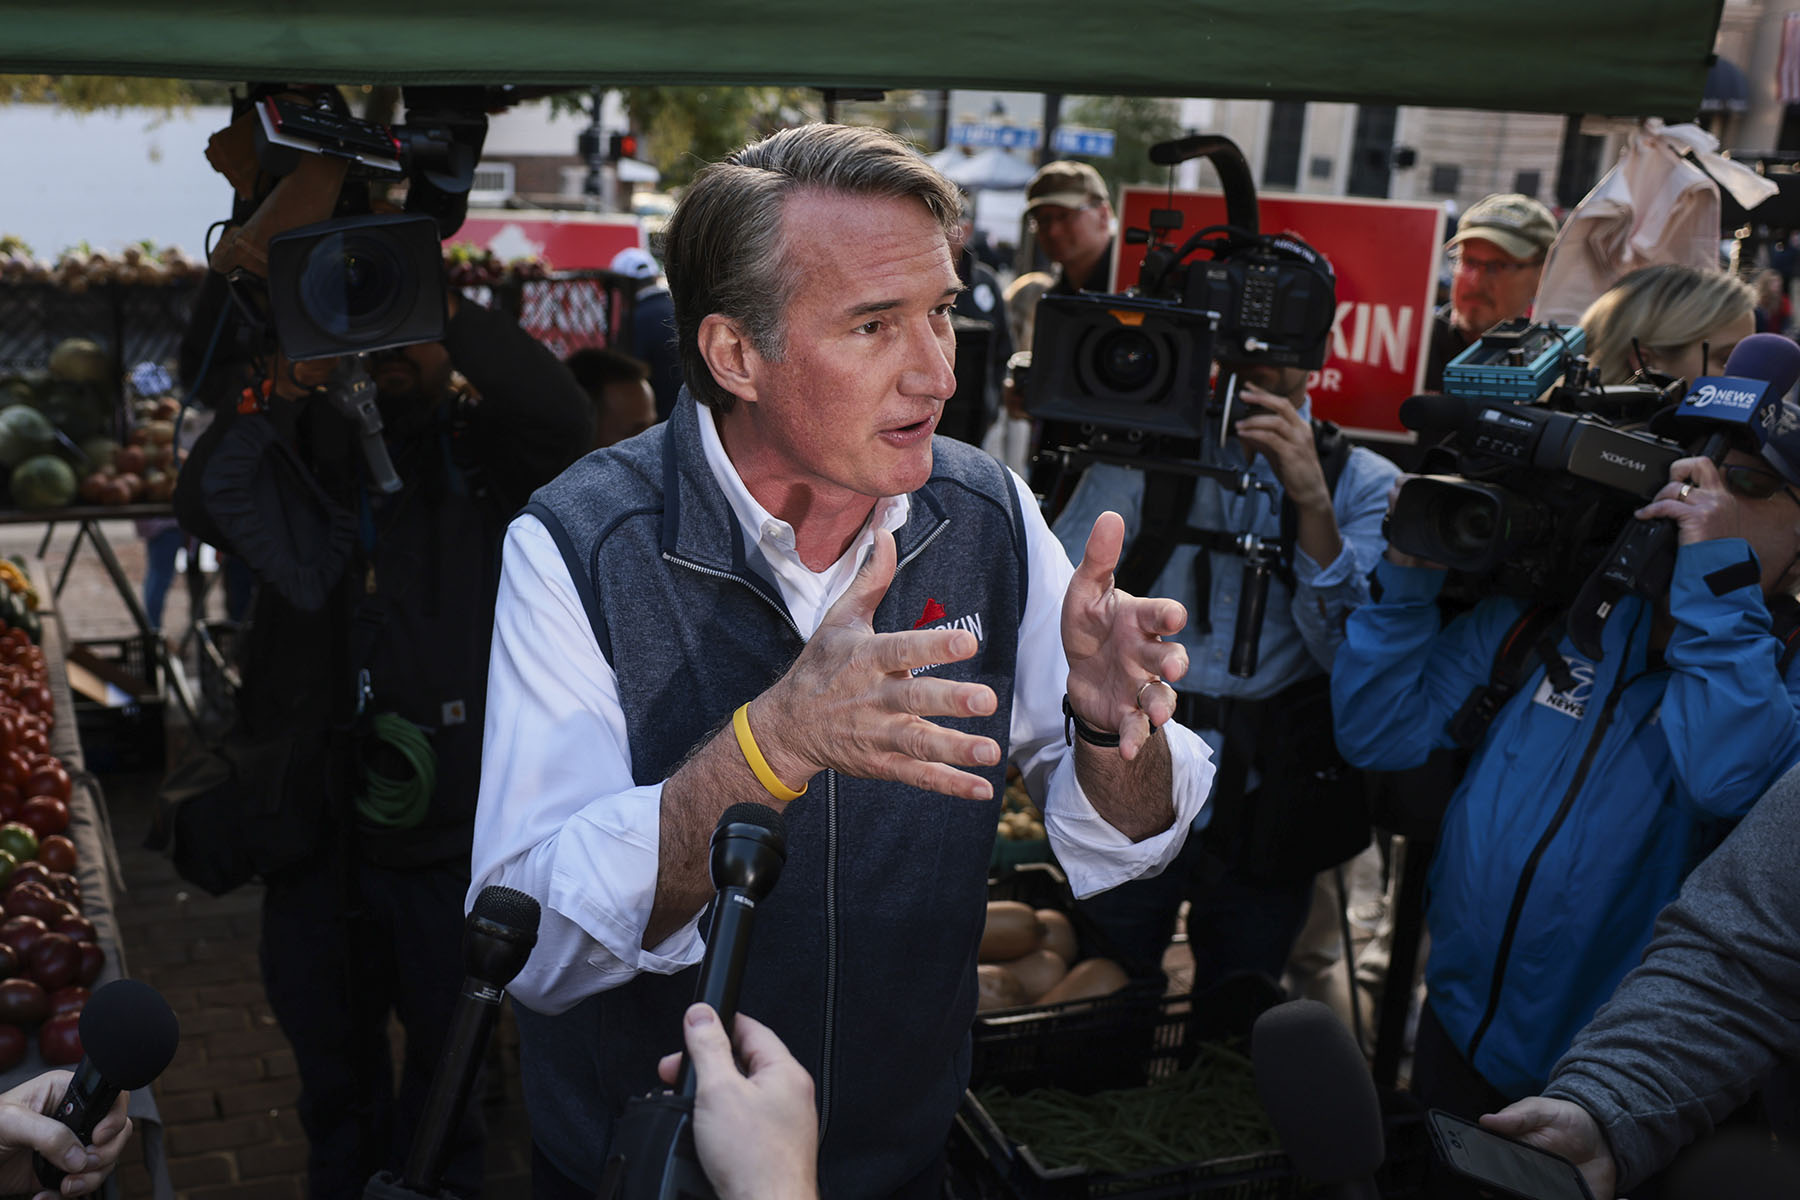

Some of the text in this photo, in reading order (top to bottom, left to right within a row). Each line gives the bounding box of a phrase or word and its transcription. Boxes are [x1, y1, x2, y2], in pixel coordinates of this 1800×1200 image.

[1715, 389, 1757, 404] NEWS
[1600, 450, 1647, 473] XDCAM
[1546, 695, 1585, 717] NEWS
